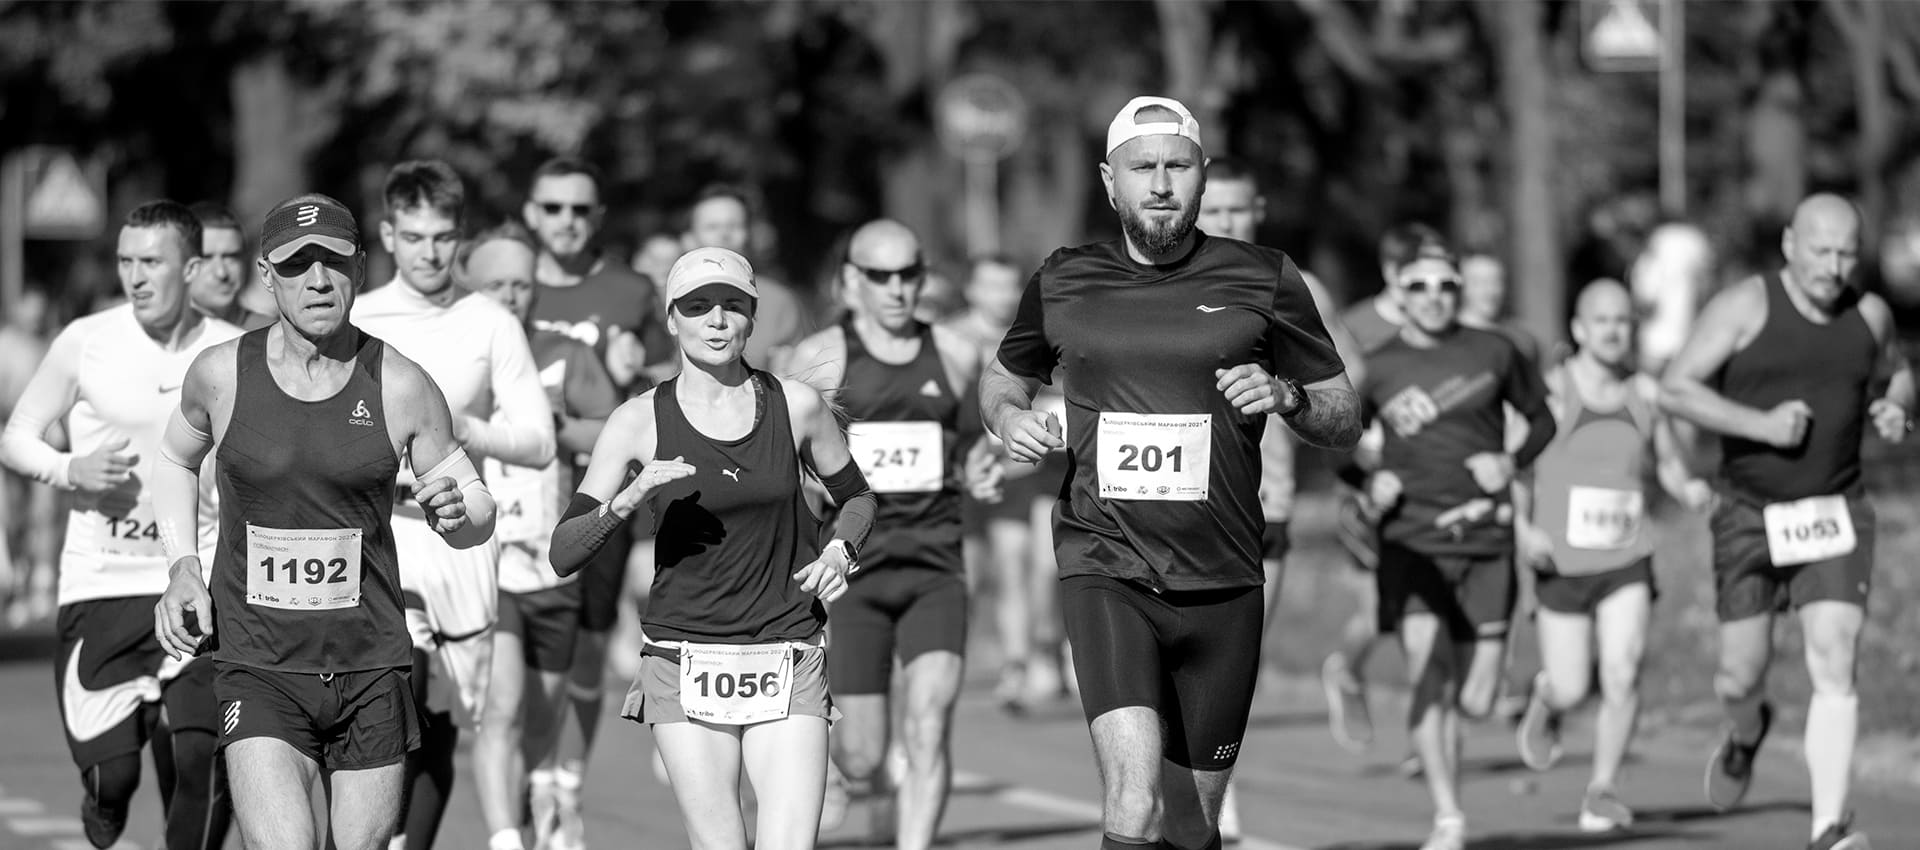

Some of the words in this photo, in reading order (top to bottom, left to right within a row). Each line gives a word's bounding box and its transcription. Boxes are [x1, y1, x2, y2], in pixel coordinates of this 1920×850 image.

[872, 447, 921, 468] 247
[1117, 444, 1183, 473] 201
[260, 556, 348, 585] 1192
[265, 595, 280, 603] tribo
[694, 672, 780, 698] 1056
